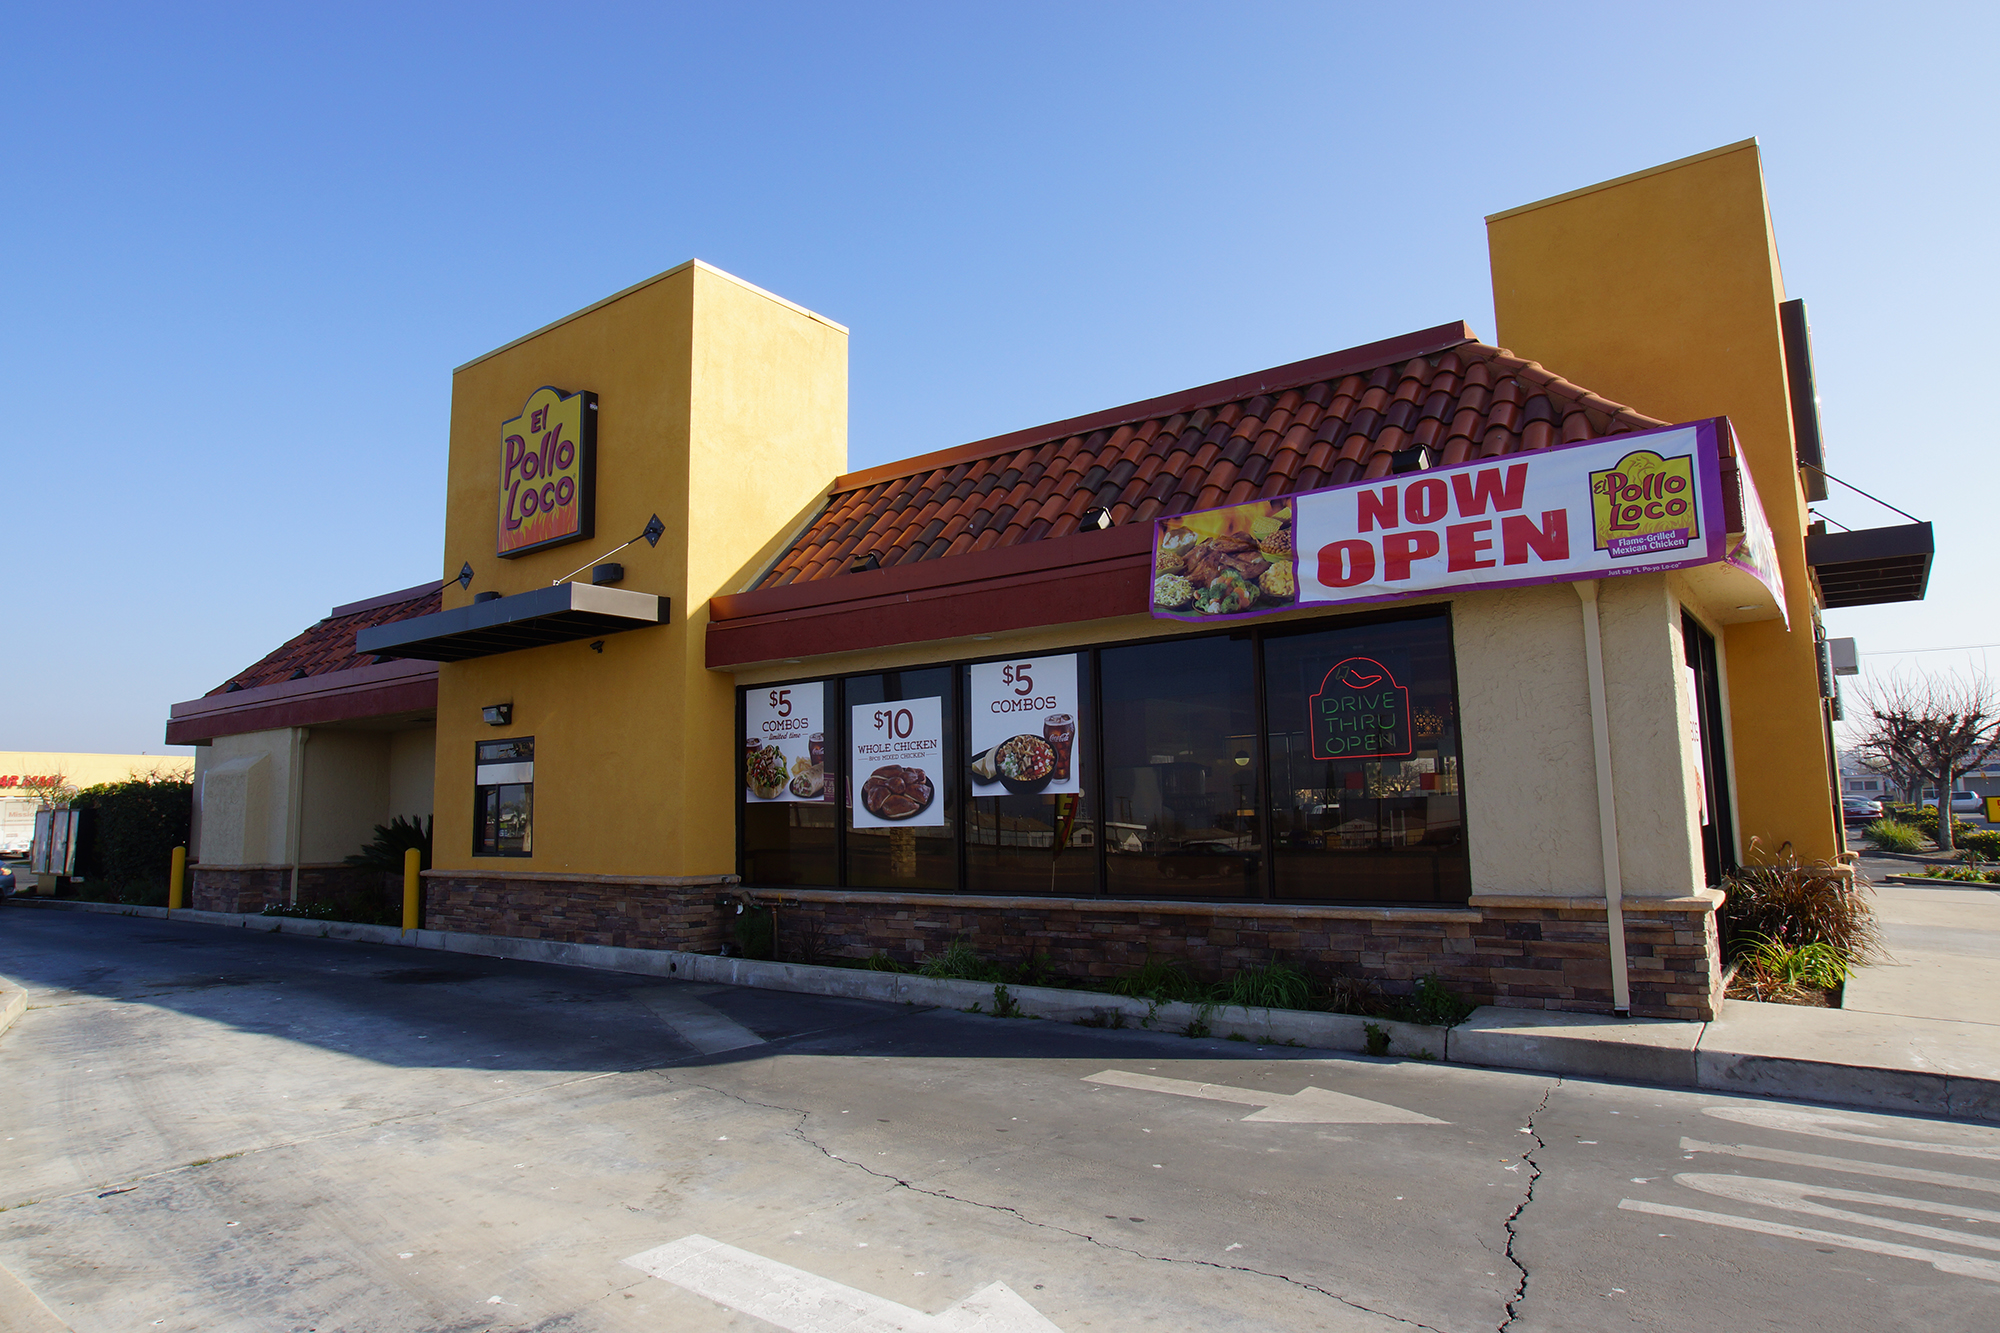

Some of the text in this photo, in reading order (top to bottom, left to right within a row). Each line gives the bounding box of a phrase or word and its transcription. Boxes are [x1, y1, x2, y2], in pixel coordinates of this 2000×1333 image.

[531, 403, 550, 434] El
[504, 422, 575, 491] Pollo
[1357, 462, 1529, 533] NOW
[1593, 471, 1687, 506] El Pollo
[506, 476, 575, 531] Loco
[1609, 498, 1687, 531] Loco
[1317, 508, 1570, 588] OPEN
[1612, 538, 1685, 555] Mexican Chicken
[1618, 530, 1676, 547] Flame-Grilled
[1002, 663, 1033, 696] $5
[769, 690, 792, 717] $5
[991, 696, 1057, 713] COMBOS
[1321, 692, 1395, 714] DRIVE
[762, 718, 809, 732] COMBOS
[873, 708, 914, 740] $10
[1324, 713, 1396, 733] THRU
[769, 731, 788, 740] limited
[857, 739, 938, 754] WHOLE CHICKEN
[1325, 733, 1397, 754] OPEN
[900, 752, 926, 760] CHICKEN
